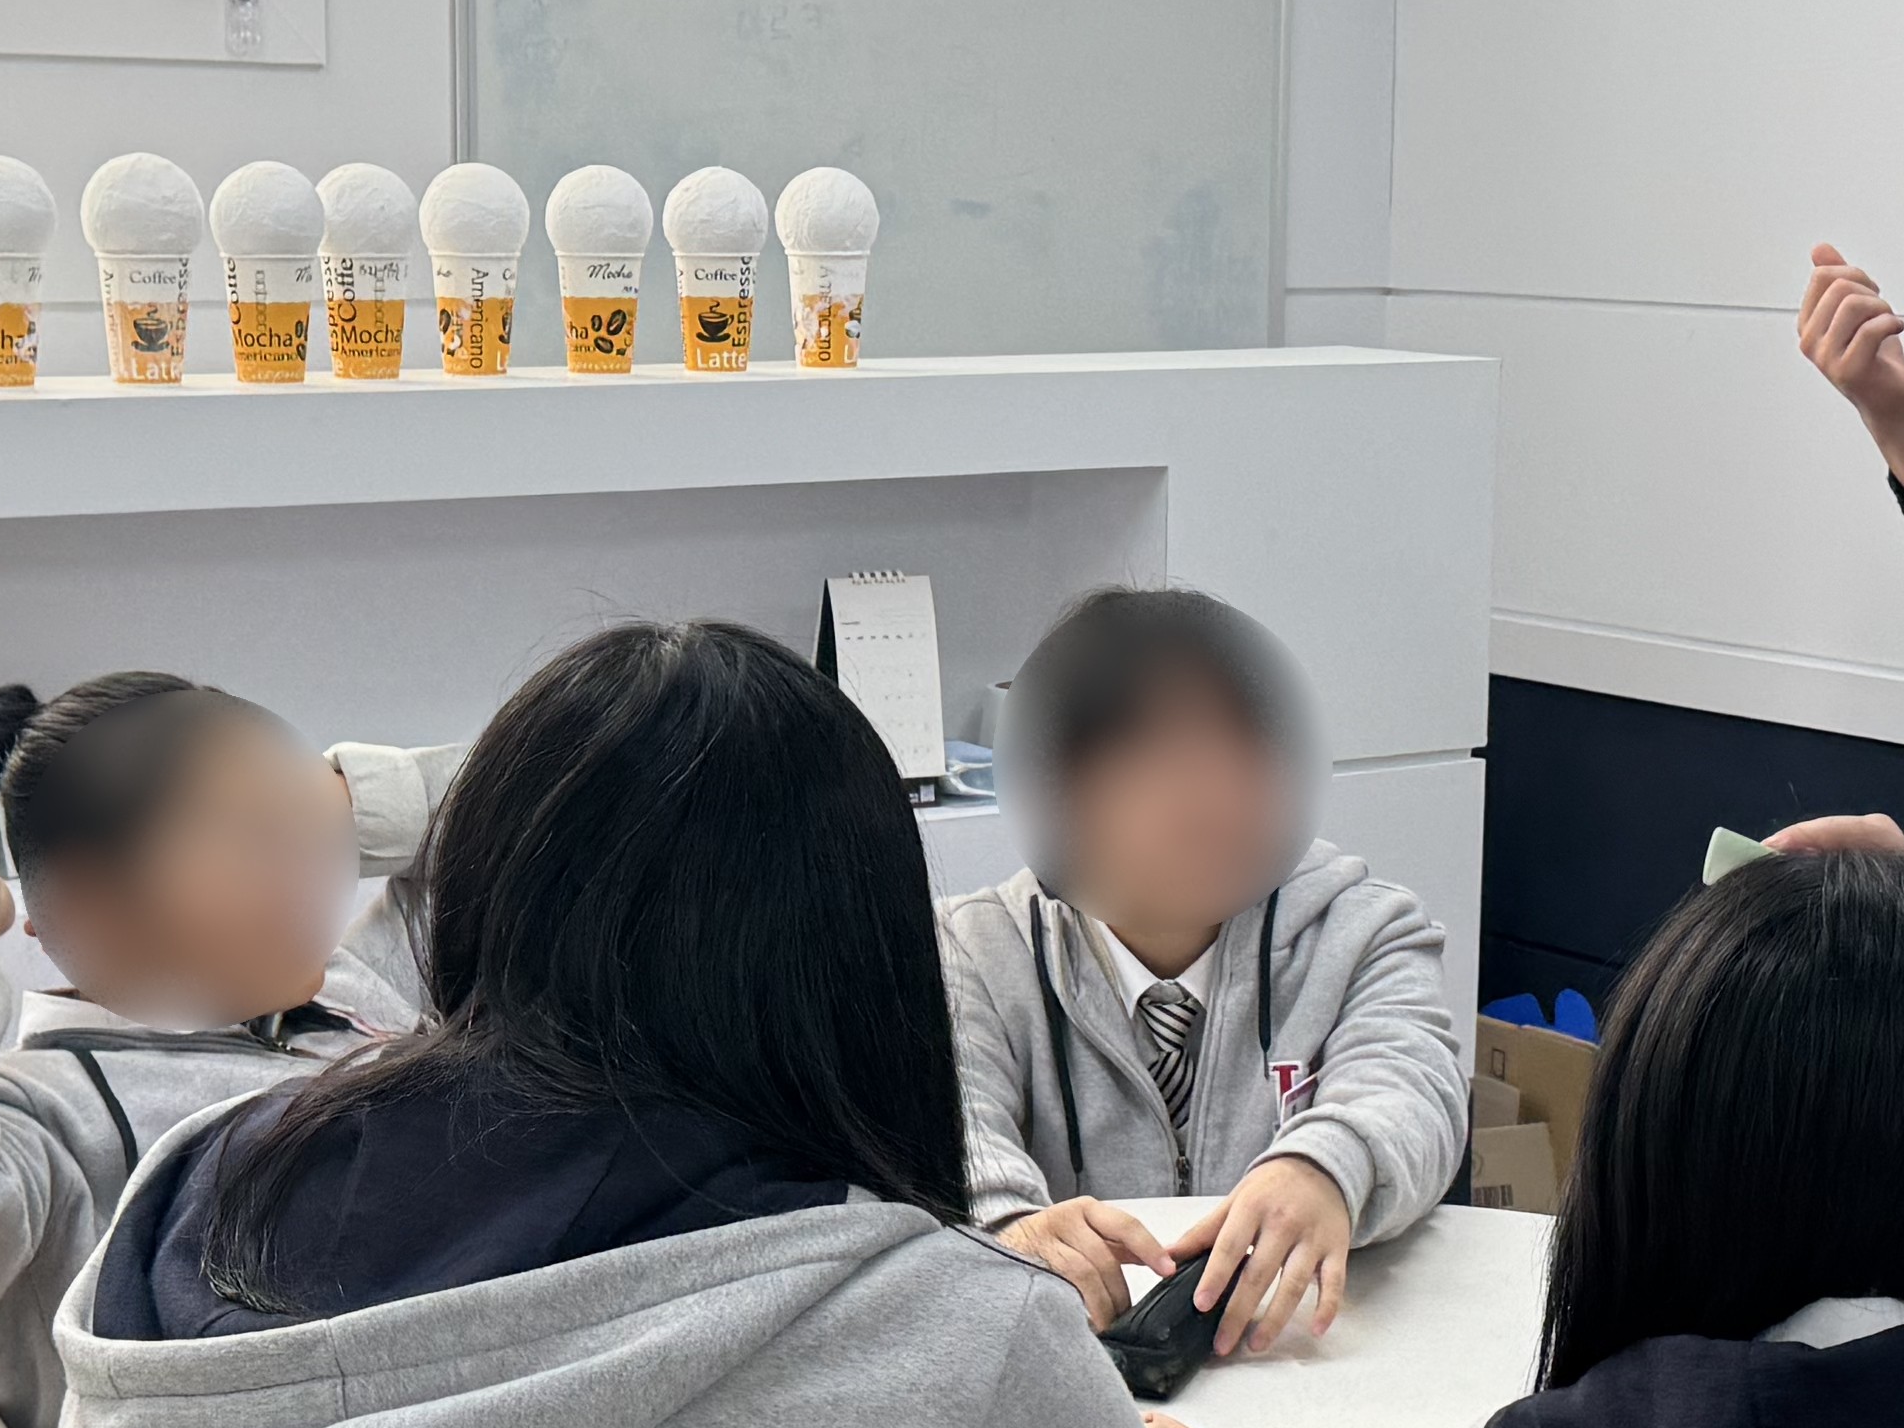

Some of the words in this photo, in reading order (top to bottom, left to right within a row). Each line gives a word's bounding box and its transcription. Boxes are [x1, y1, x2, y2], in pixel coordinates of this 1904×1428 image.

[129, 270, 177, 284] Coffee
[694, 268, 738, 281] Coffee
[470, 267, 489, 369] Americano
[696, 348, 747, 369] Latte
